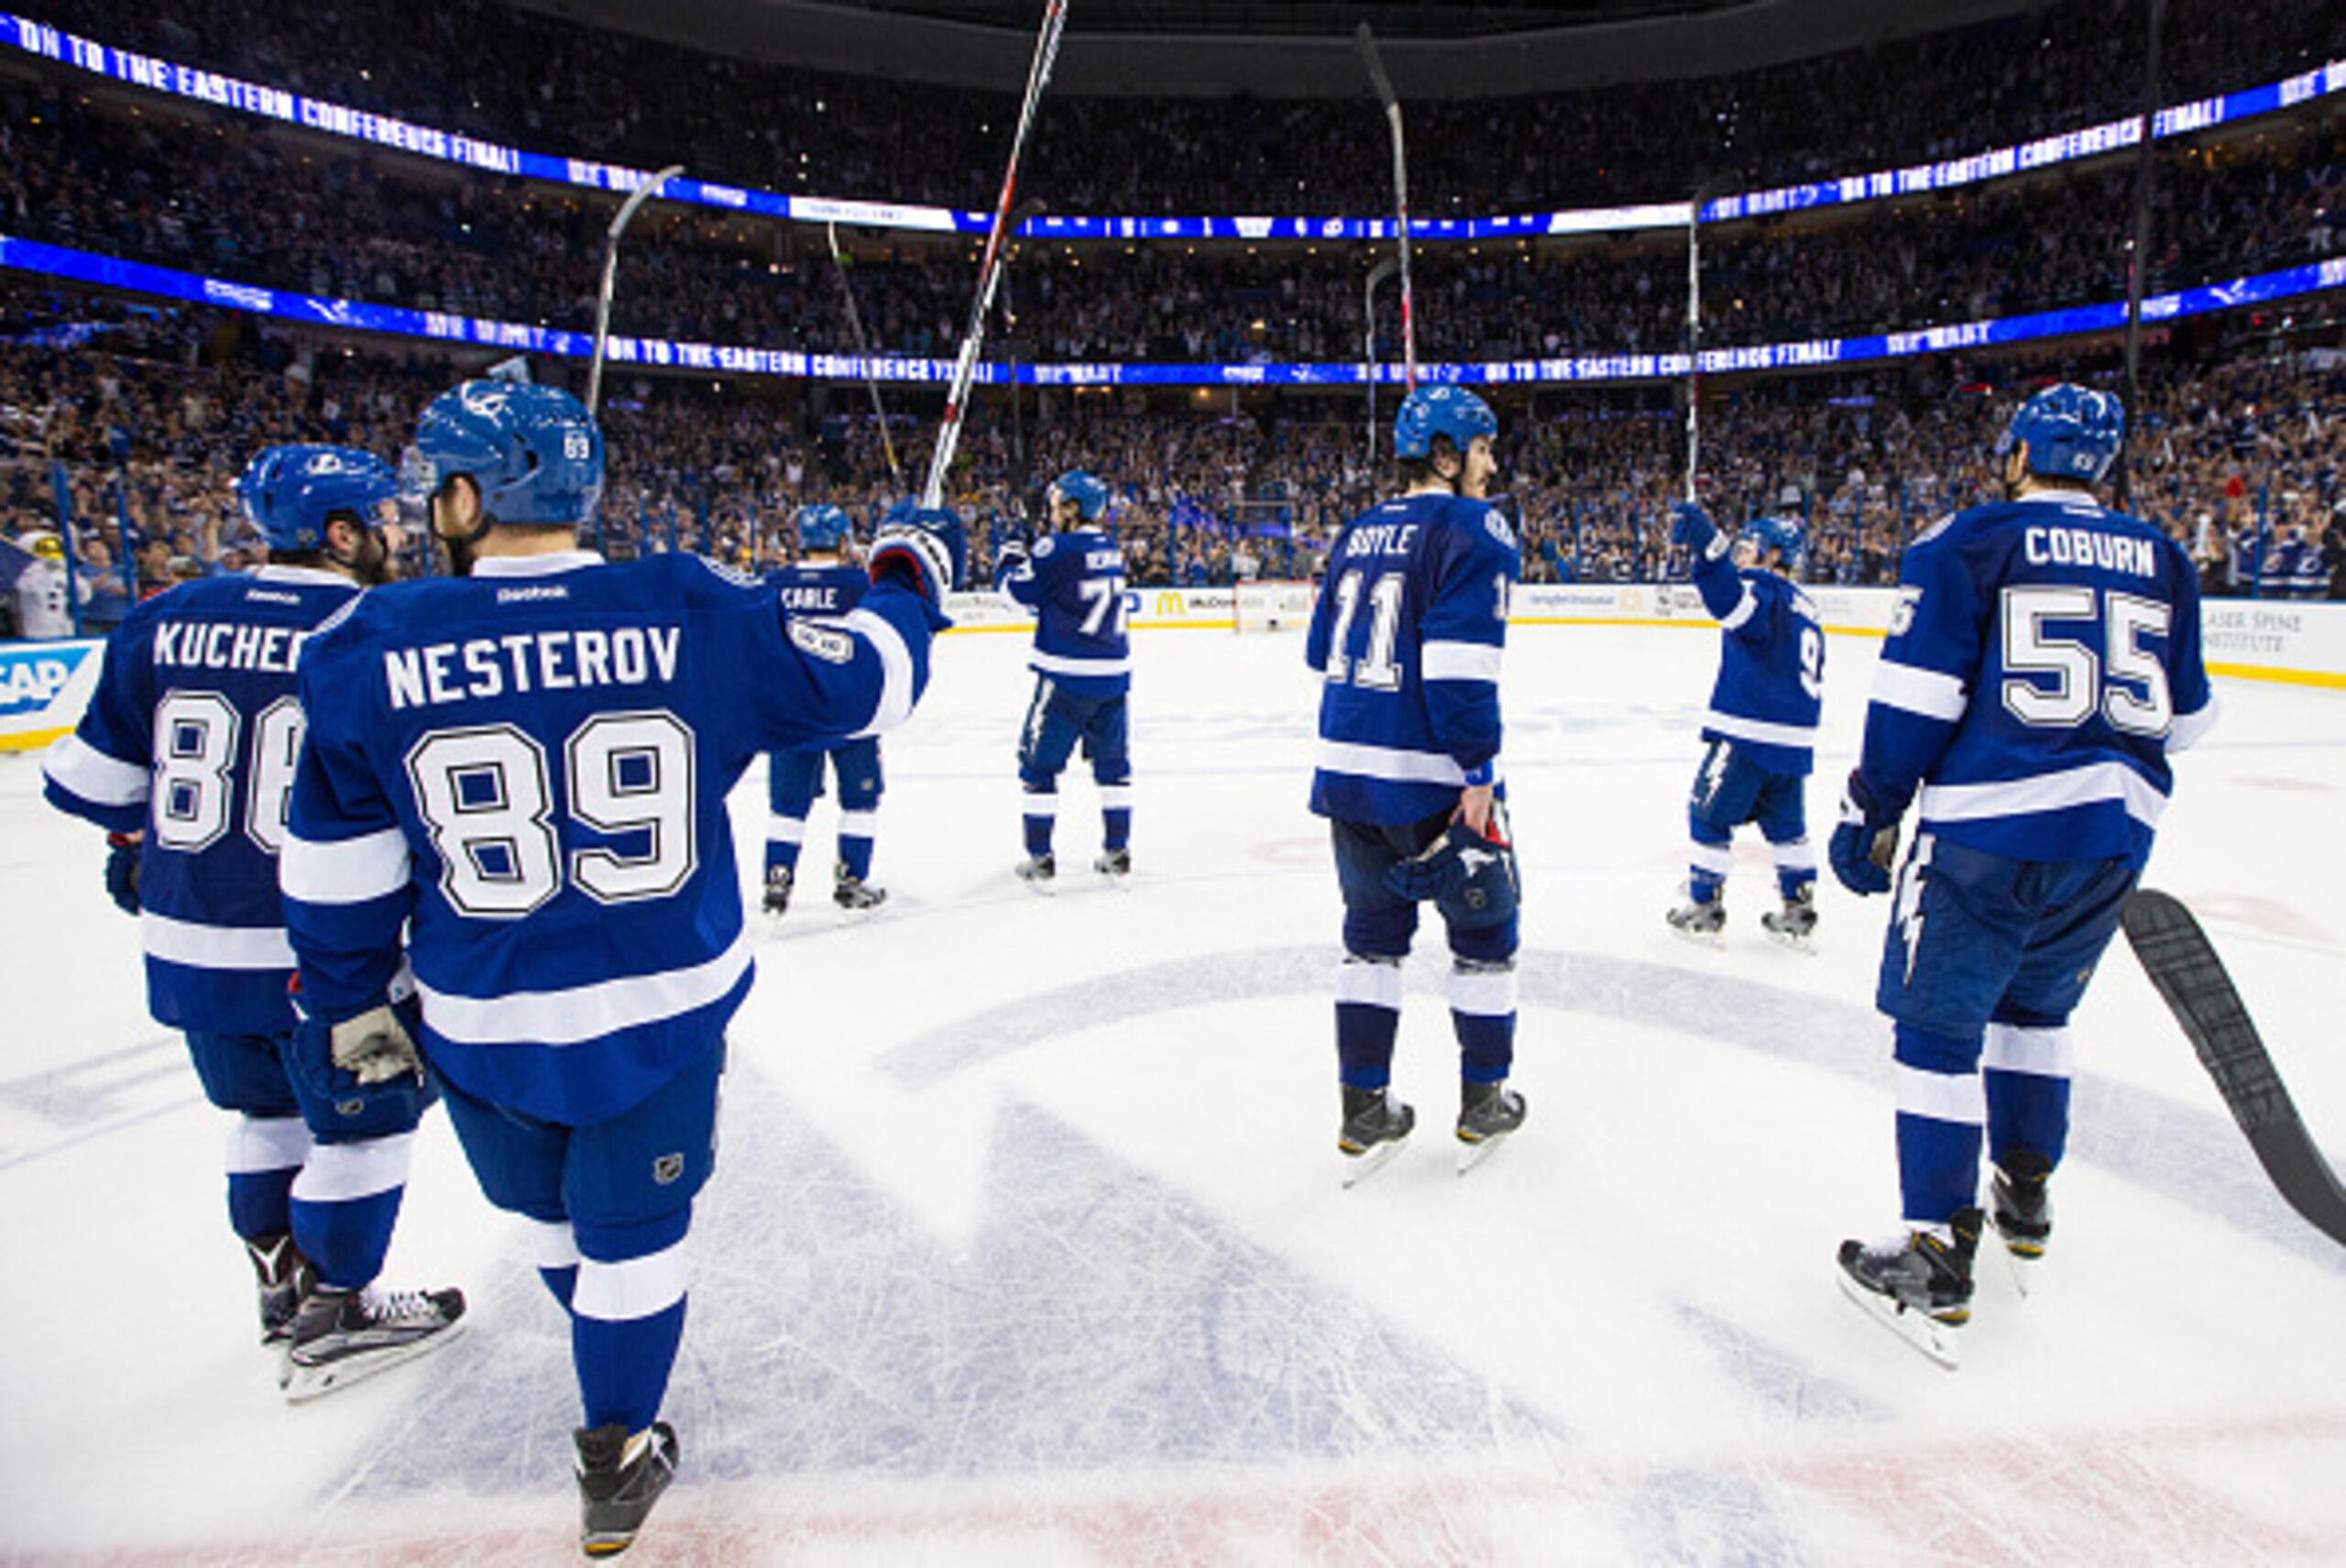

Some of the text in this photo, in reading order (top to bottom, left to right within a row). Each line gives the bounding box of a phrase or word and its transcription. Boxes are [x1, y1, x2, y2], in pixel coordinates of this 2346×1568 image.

[15, 16, 520, 174] ON TO THE EASTERN CONFERENCE FINAL!
[1840, 176, 1865, 202] ON
[1870, 170, 1893, 195] TO
[1899, 164, 1933, 192] THE
[1935, 146, 2015, 187] EASTERN
[2018, 115, 2144, 169] CONFERENCE
[607, 335, 637, 361] ON
[641, 338, 670, 365] TO
[675, 343, 716, 368] THE
[720, 346, 806, 377] EASTERN
[813, 355, 929, 381] CONFERENCE
[1512, 361, 1536, 380] TO
[1540, 358, 1573, 380] THE
[1576, 355, 1654, 379] EASTERN
[1658, 345, 1770, 376] COFERENCE
[1777, 339, 1841, 366] FINAL!
[1345, 524, 1419, 556] BOYLE
[2025, 526, 2156, 577] COBURN
[1325, 568, 1405, 693] 11
[2201, 630, 2285, 652] NSTITUTE
[2203, 611, 2301, 632] ASER SPINE
[384, 627, 681, 710] NESTEROV
[2000, 584, 2173, 739] 55
[403, 707, 698, 919] 89
